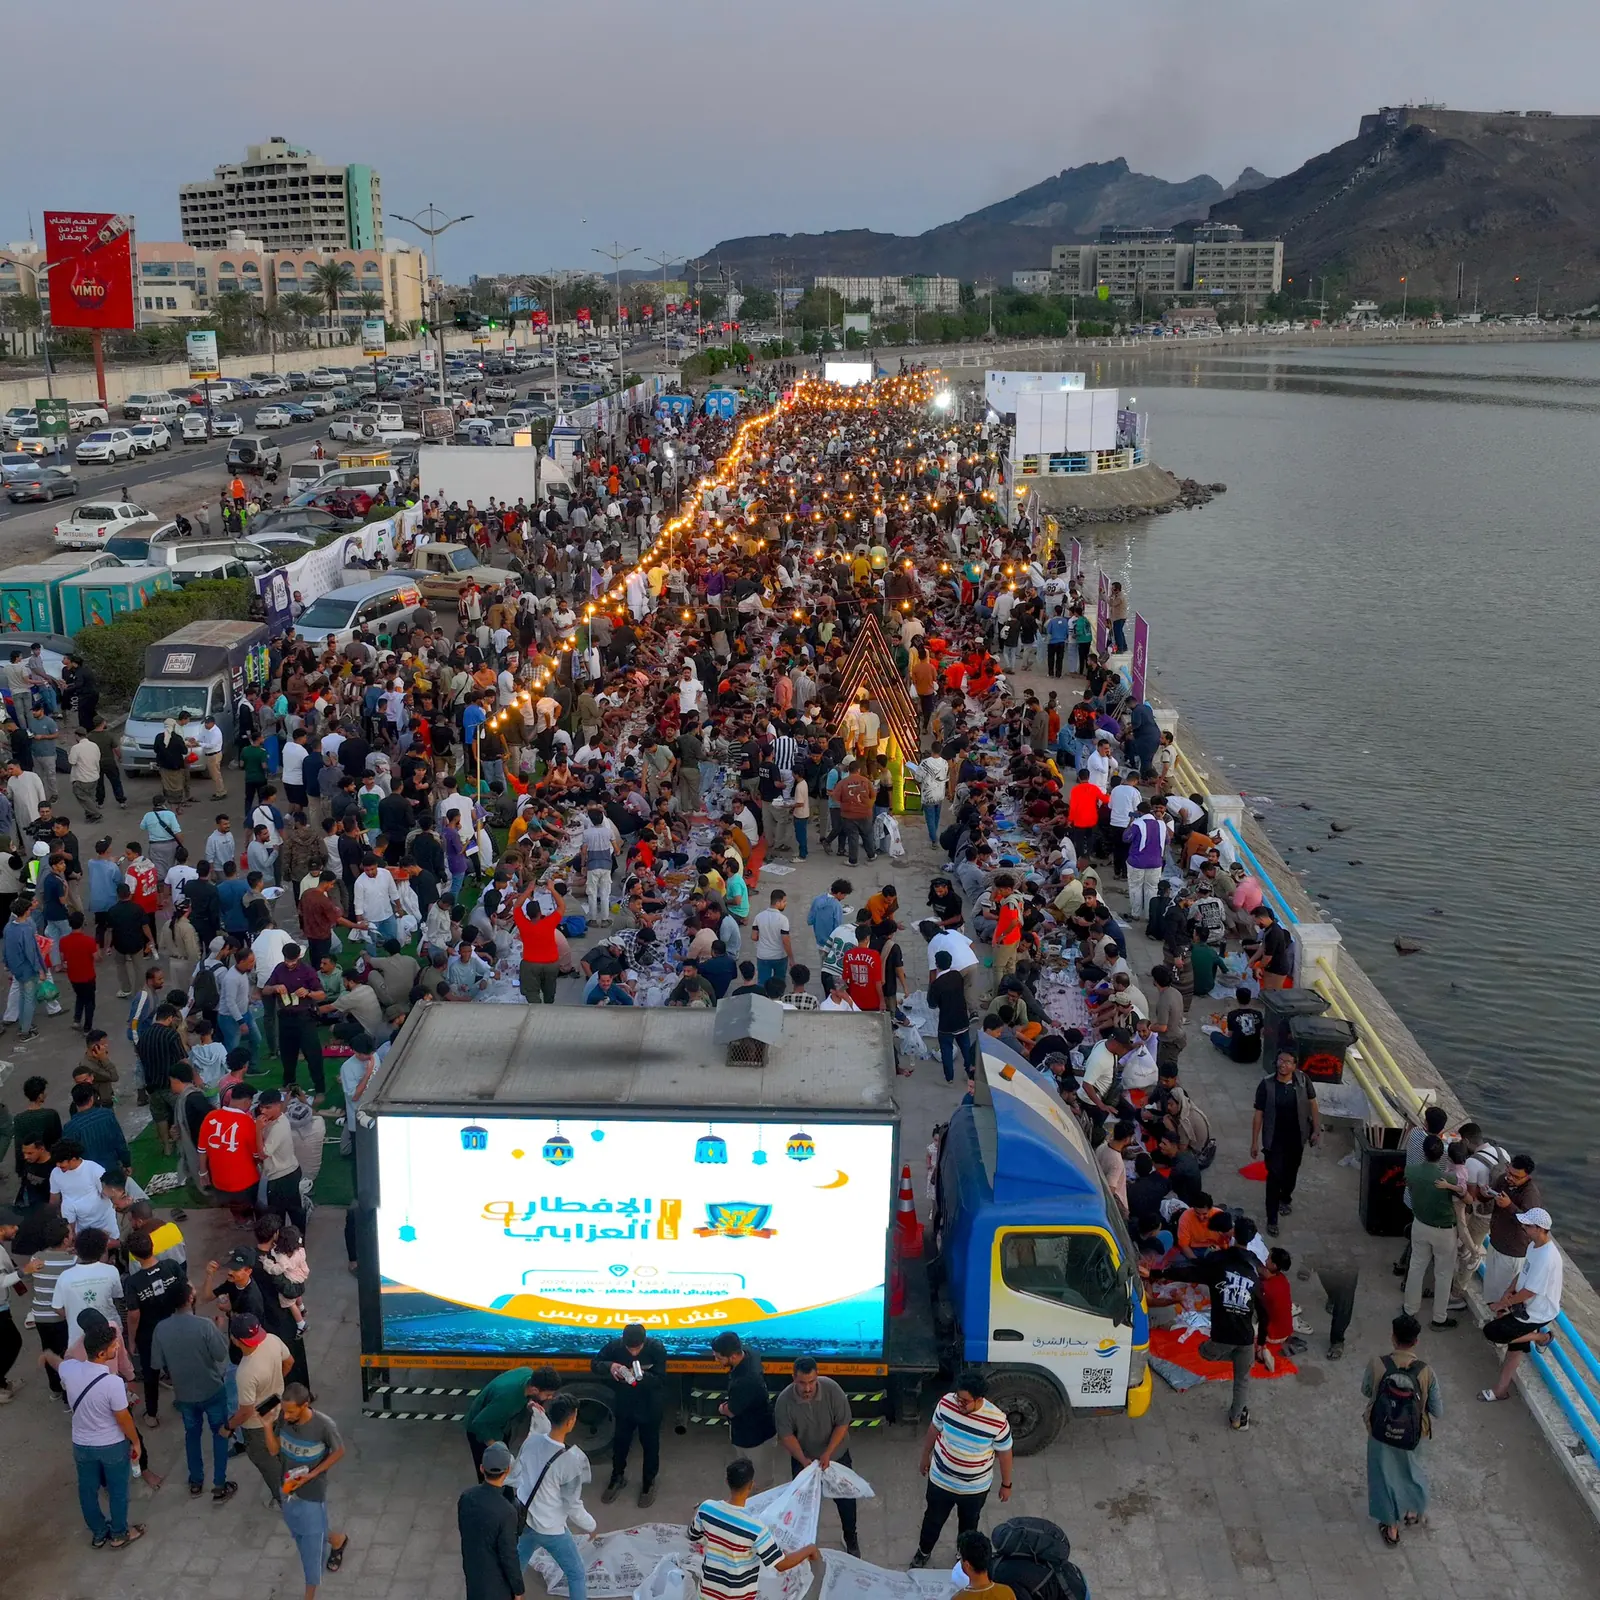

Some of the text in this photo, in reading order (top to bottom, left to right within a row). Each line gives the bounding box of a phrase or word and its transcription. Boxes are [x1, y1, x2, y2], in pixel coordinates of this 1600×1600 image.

[72, 218, 98, 226] الطعم
[59, 233, 82, 241] رمضان
[72, 285, 105, 296] VIMTO
[208, 1118, 239, 1152] 24
[503, 1218, 652, 1242] العزابي
[538, 1308, 599, 1324] وبس
[604, 1312, 670, 1325] إفطار
[1032, 1336, 1089, 1349] بحار الشرق
